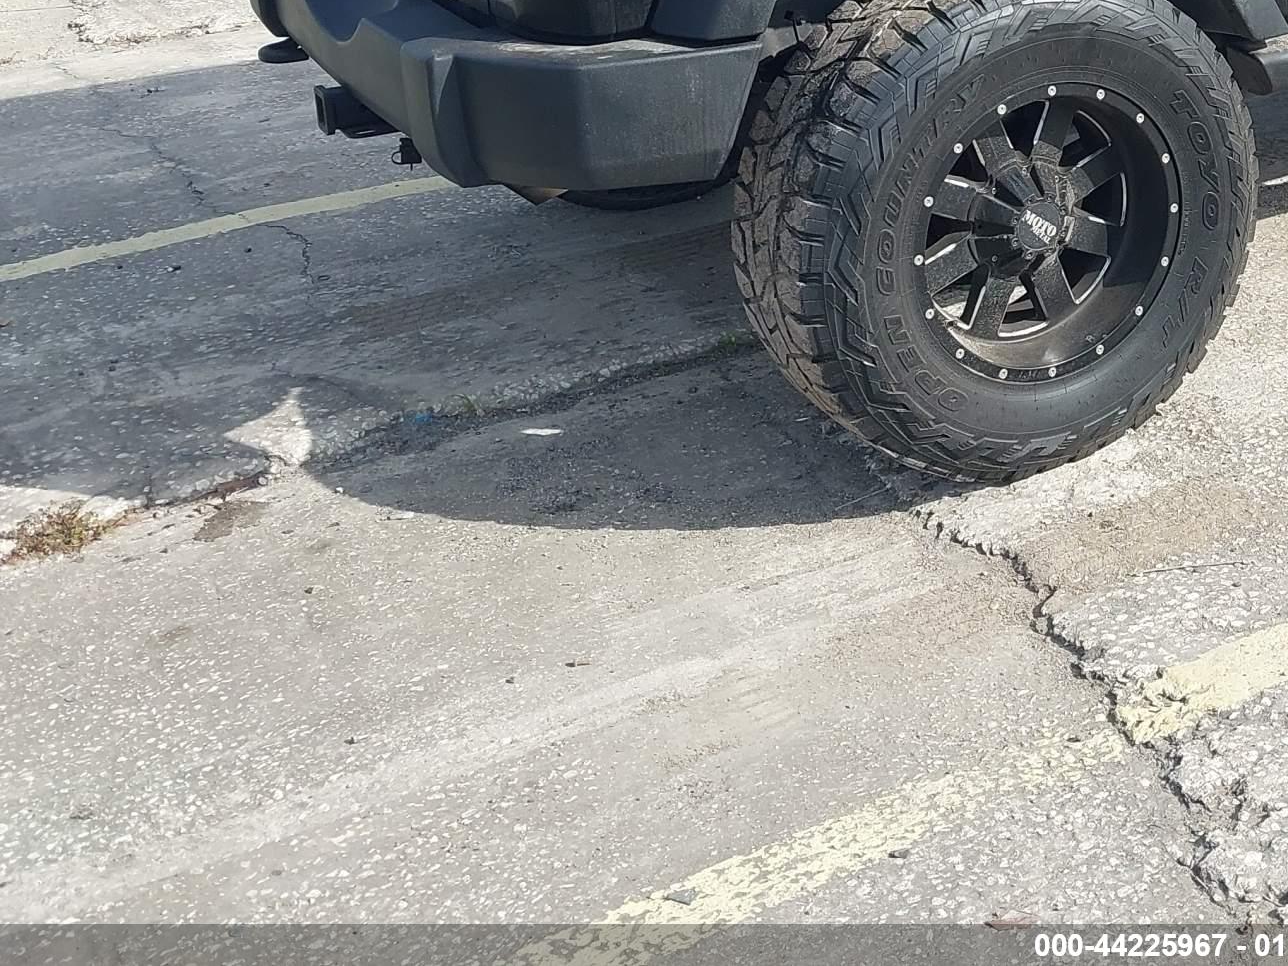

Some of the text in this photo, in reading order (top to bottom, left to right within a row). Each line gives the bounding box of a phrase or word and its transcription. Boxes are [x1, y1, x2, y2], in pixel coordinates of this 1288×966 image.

[1168, 88, 1220, 232] TOYO
[1021, 209, 1057, 237] MOTO
[1030, 226, 1052, 244] METAL
[882, 314, 970, 413] OPEN
